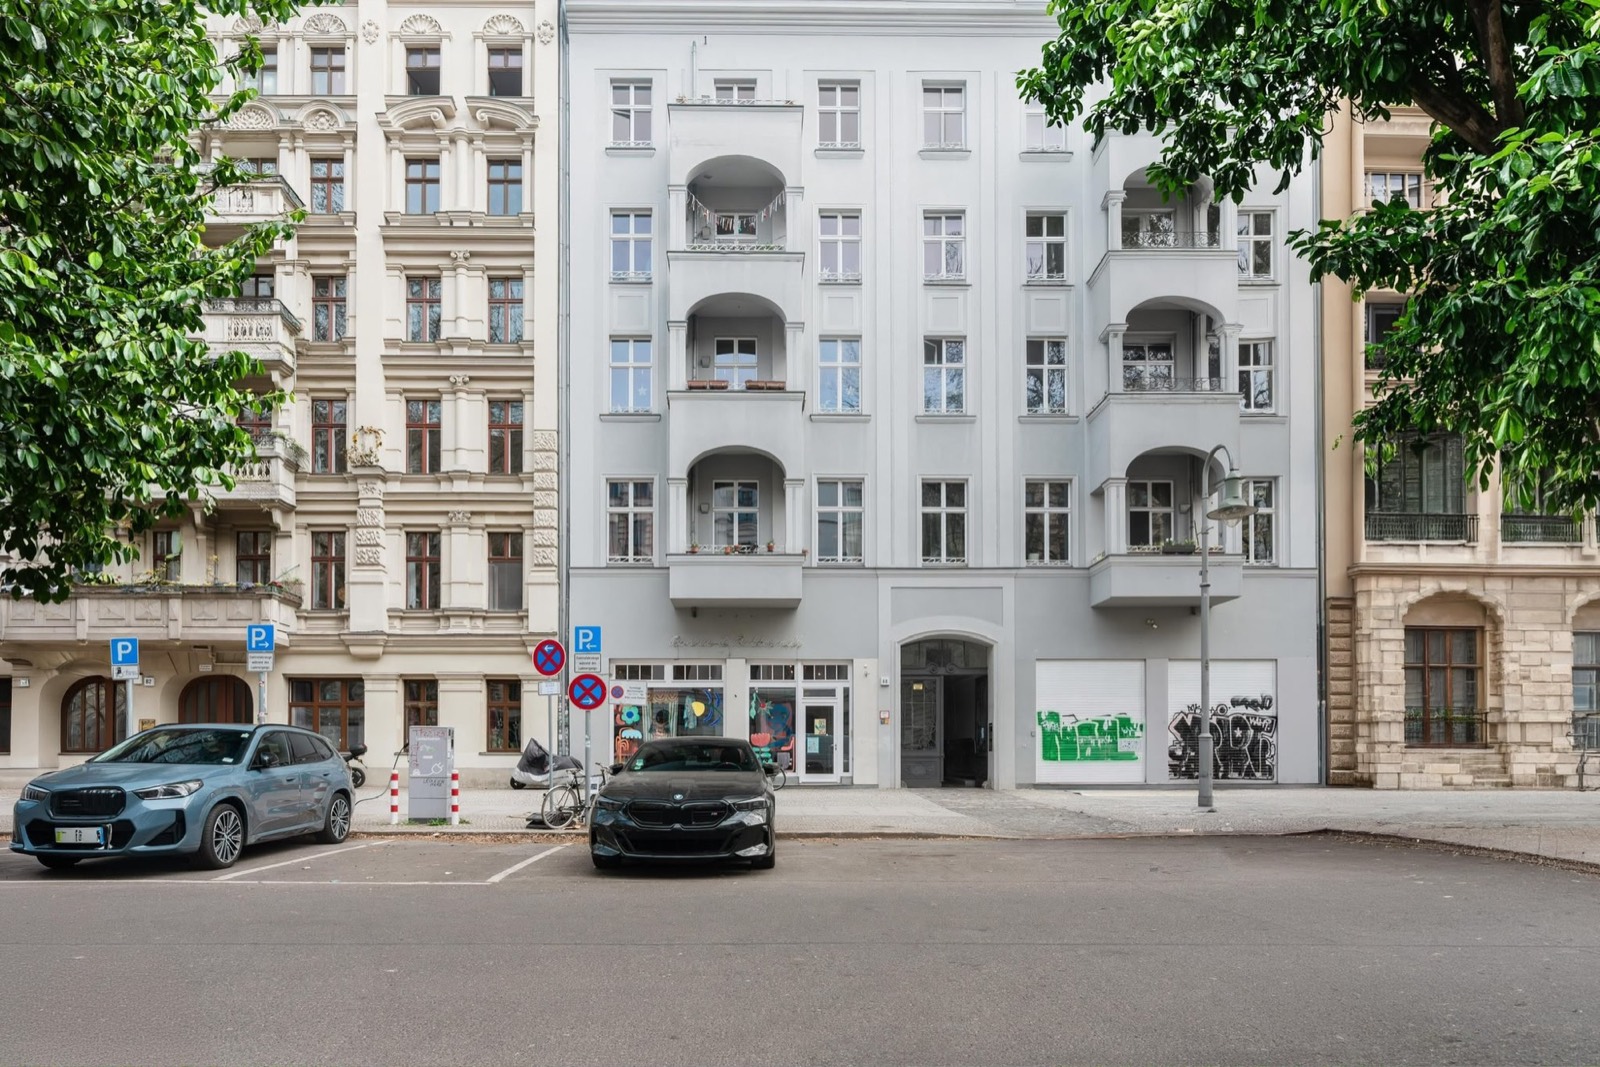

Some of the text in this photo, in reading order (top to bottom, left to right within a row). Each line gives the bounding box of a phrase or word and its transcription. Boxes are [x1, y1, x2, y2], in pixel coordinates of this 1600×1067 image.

[251, 627, 266, 649] P
[578, 629, 593, 650] P
[117, 641, 132, 662] P
